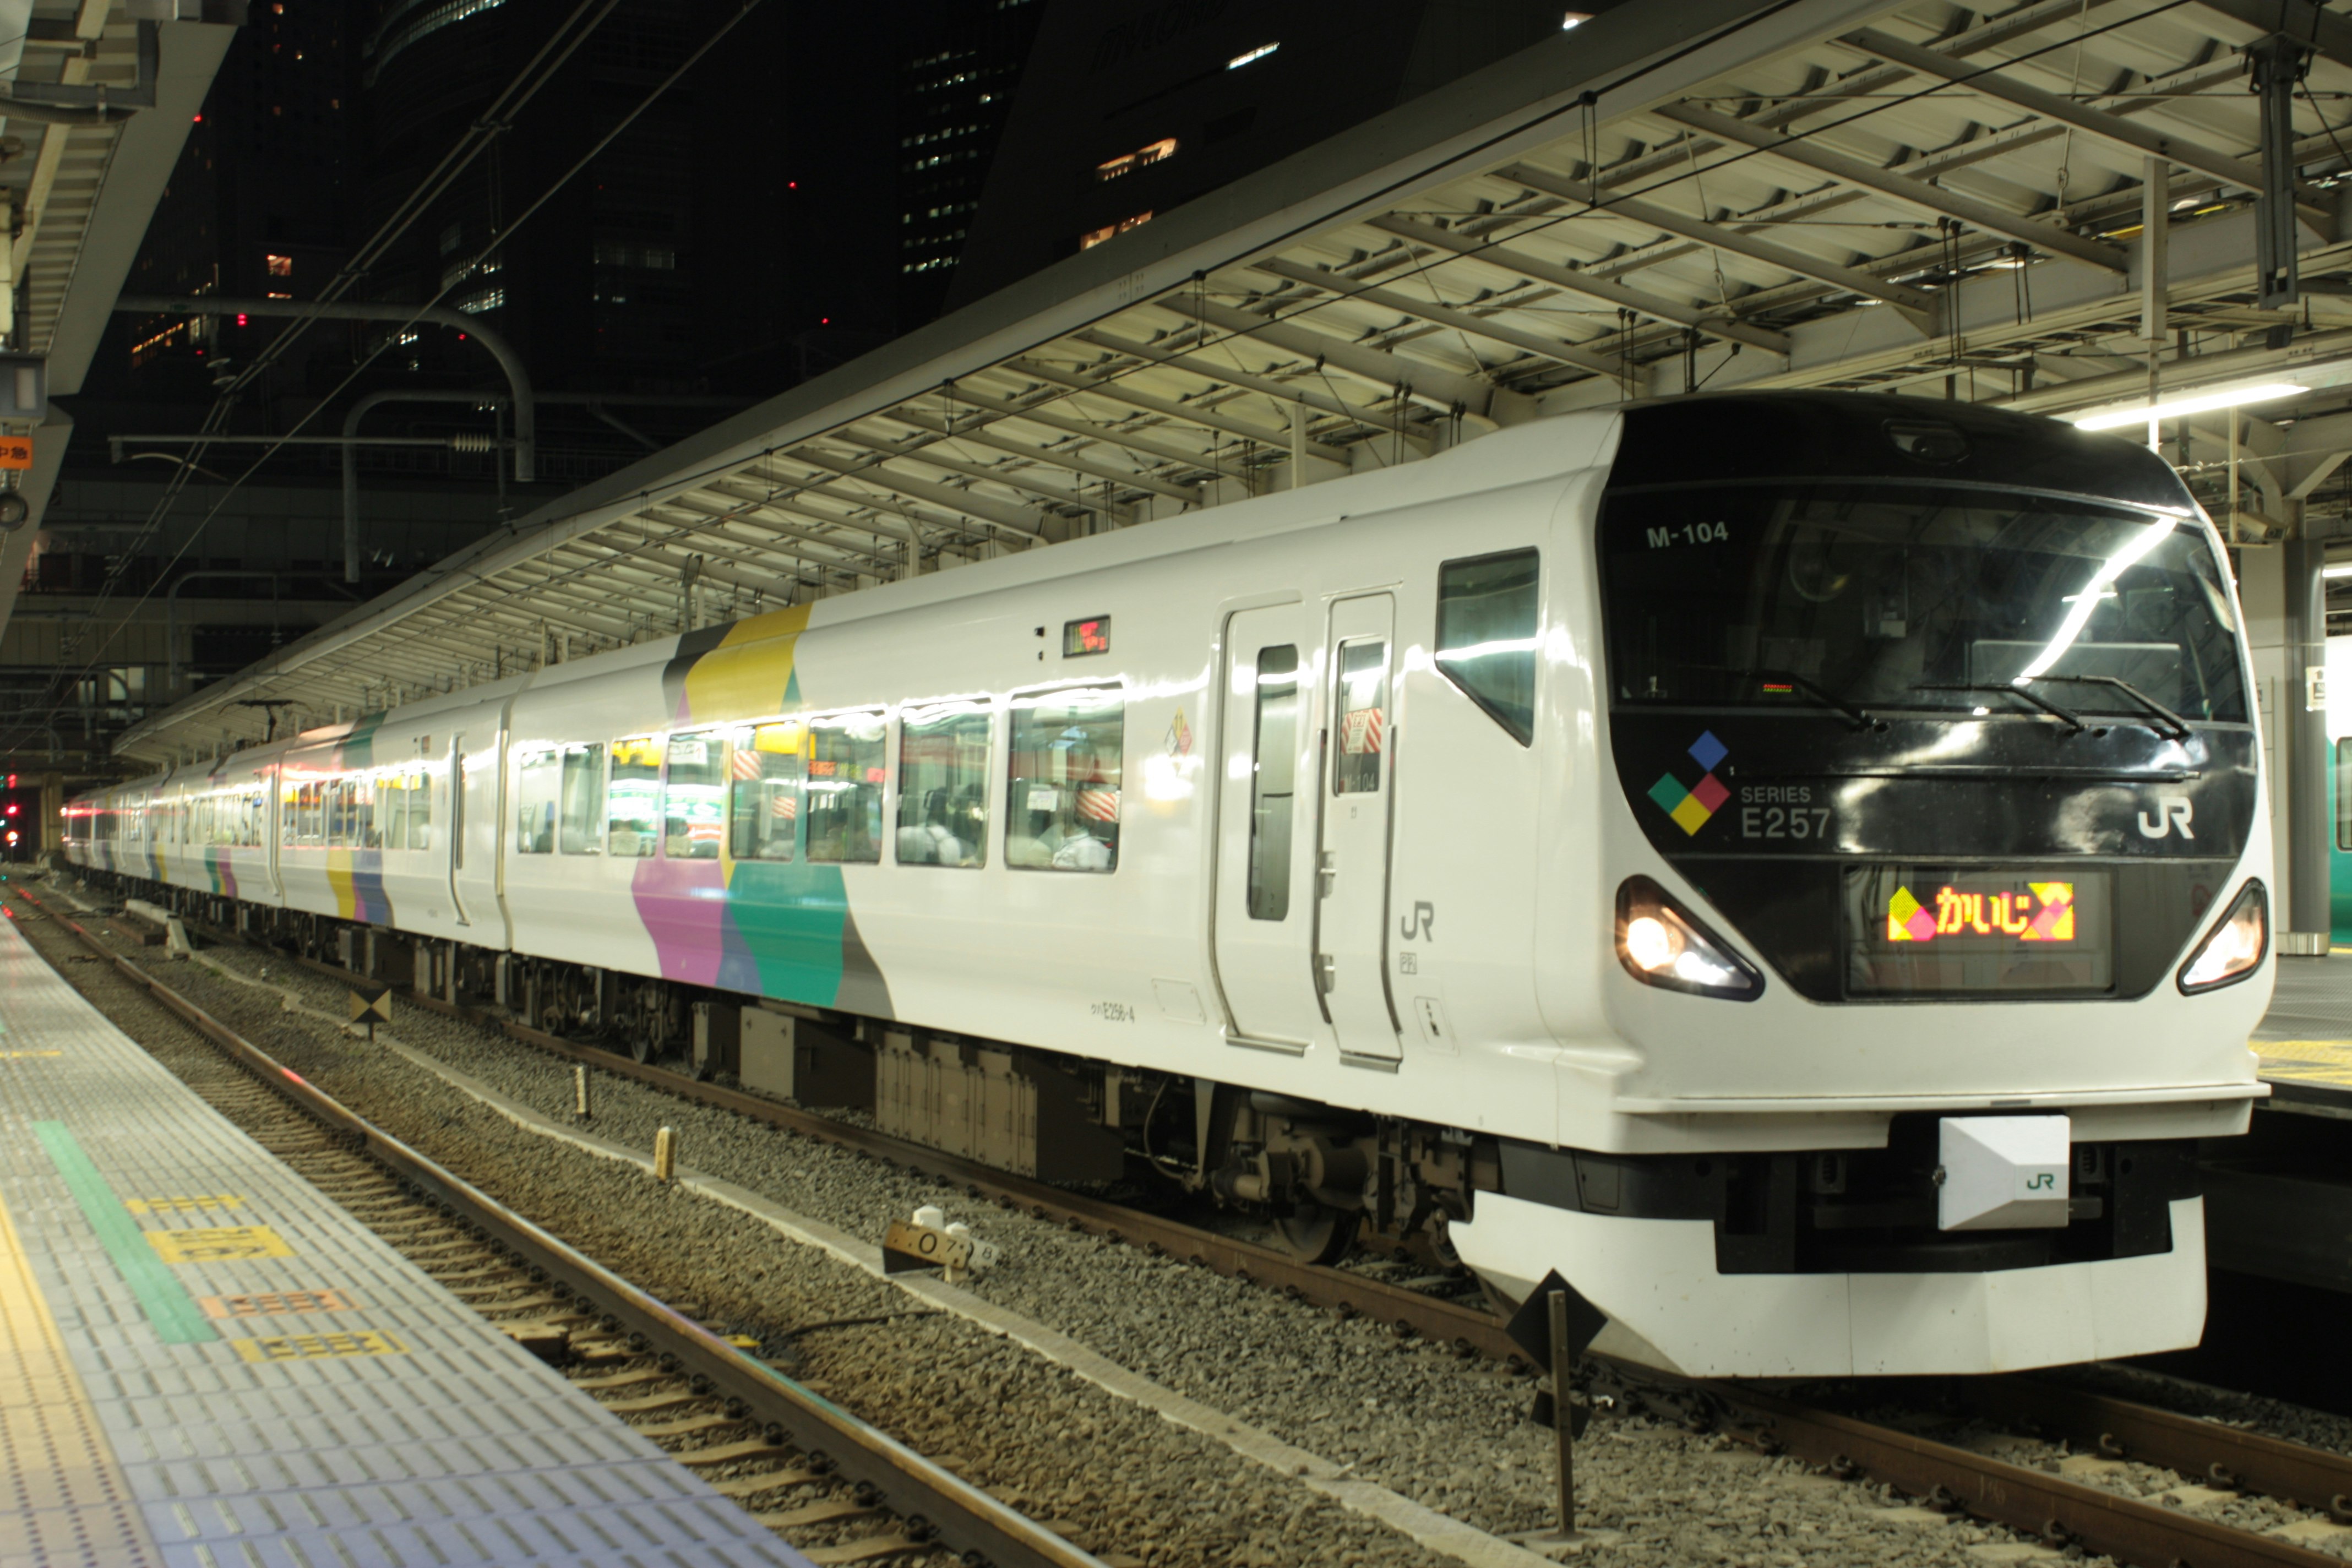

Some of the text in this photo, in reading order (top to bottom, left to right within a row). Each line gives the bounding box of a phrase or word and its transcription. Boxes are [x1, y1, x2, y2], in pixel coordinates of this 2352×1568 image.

[1647, 522, 1729, 549] M-104
[1741, 786, 1811, 803] SERIES
[1742, 807, 1831, 839] E257
[2138, 796, 2195, 839] JR
[1401, 901, 1434, 942] JR
[1936, 886, 2030, 934] かいじ
[2027, 1173, 2054, 1190] JR
